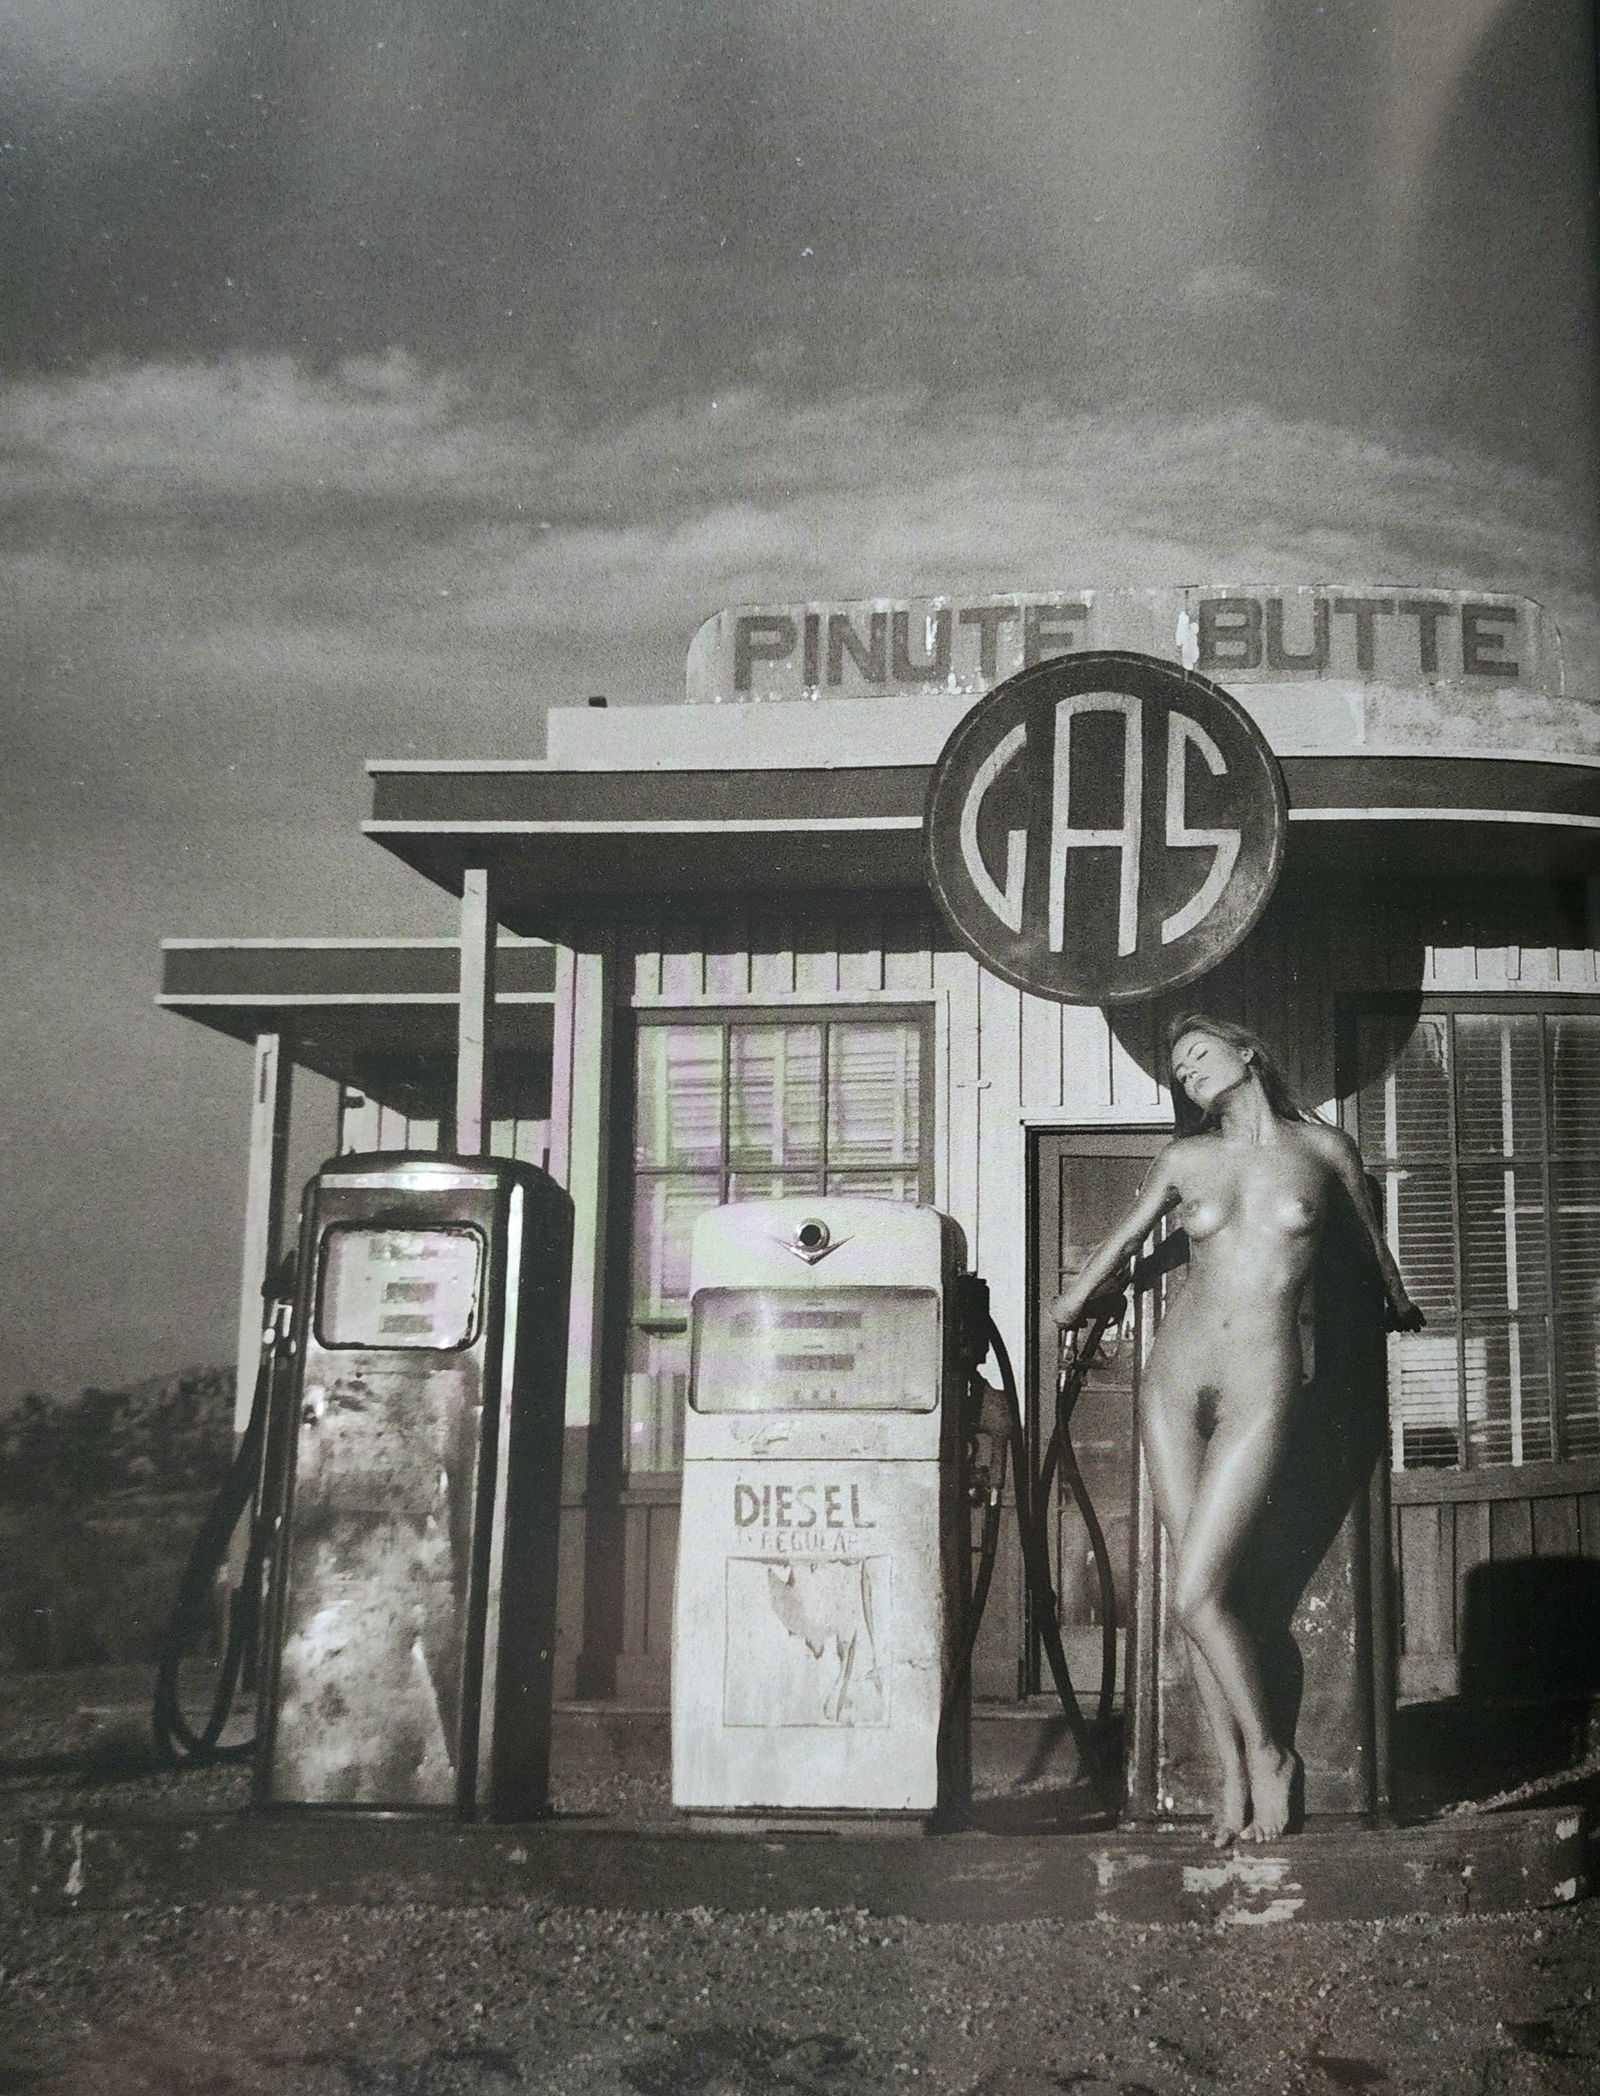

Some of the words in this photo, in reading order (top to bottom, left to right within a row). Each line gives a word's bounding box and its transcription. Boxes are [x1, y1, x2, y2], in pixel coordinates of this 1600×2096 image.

[1199, 597, 1519, 676] BUTTE
[960, 691, 1241, 957] GAS
[734, 1484, 876, 1528] DIESEL
